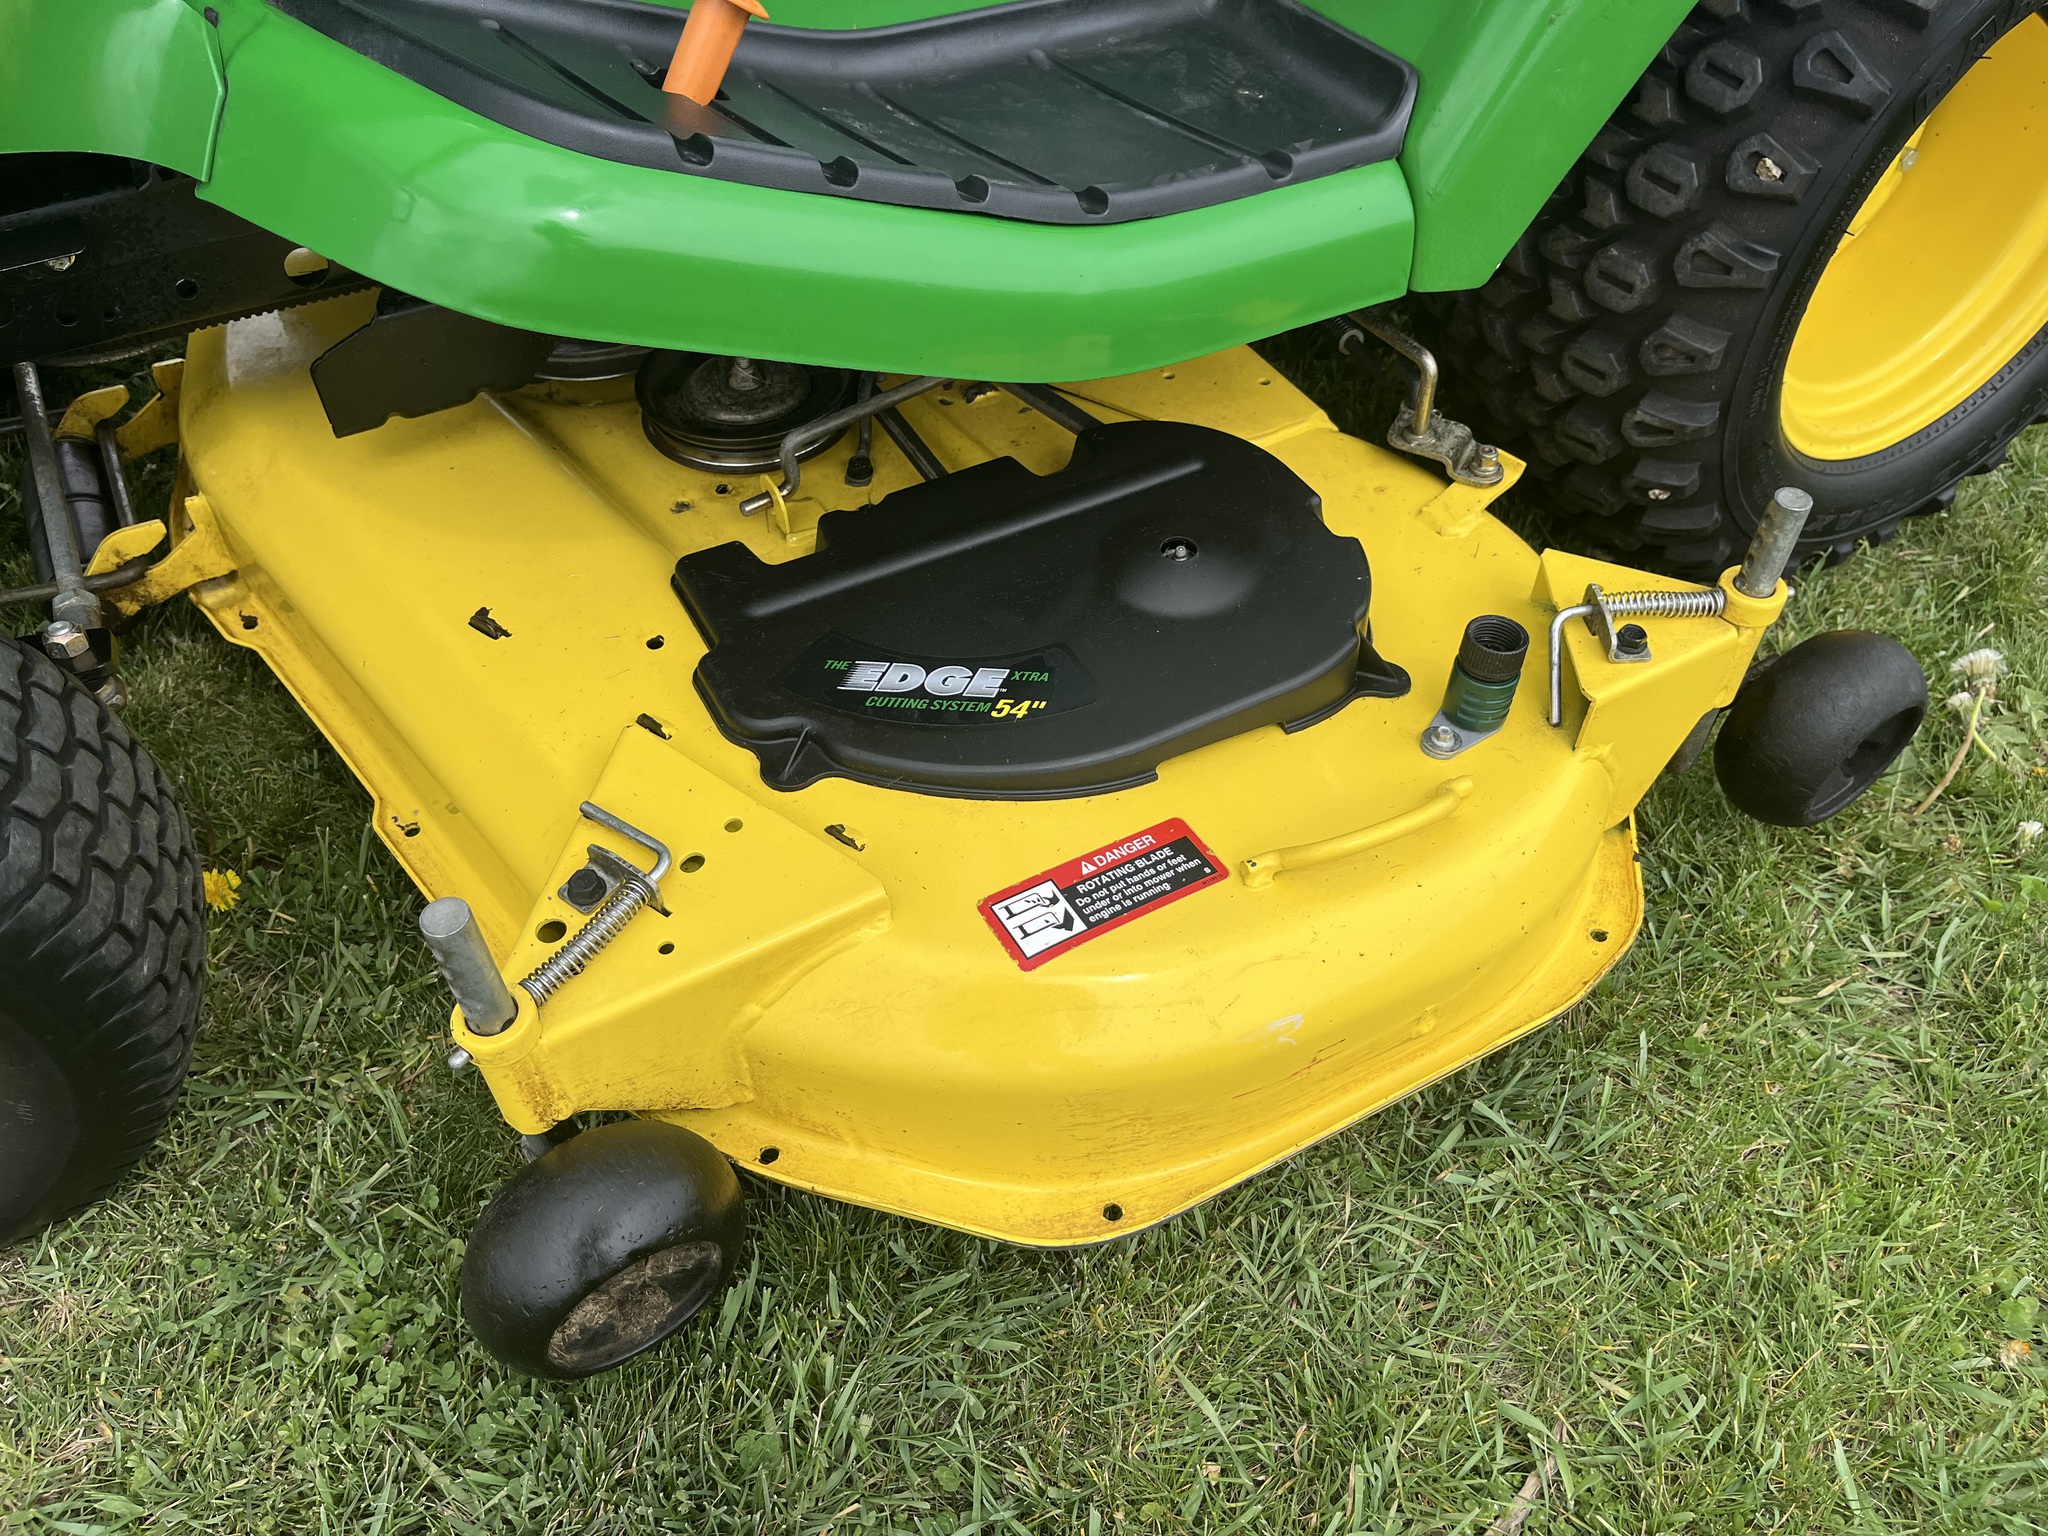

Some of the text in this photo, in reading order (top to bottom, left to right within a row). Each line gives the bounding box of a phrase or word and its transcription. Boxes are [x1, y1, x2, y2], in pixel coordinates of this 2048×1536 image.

[824, 659, 853, 671] THE
[837, 660, 1010, 698] EDGE
[1011, 670, 1049, 682] XTRA
[865, 696, 1047, 719] CUTTING SYSTEM 54"
[1093, 835, 1156, 867] DANGER
[1075, 853, 1187, 907] Do not put hands or feet
[1076, 846, 1174, 894] ROTATING BLADE
[1082, 858, 1202, 914] under or into mower when
[1088, 903, 1122, 922] engine
[1120, 899, 1133, 908] is
